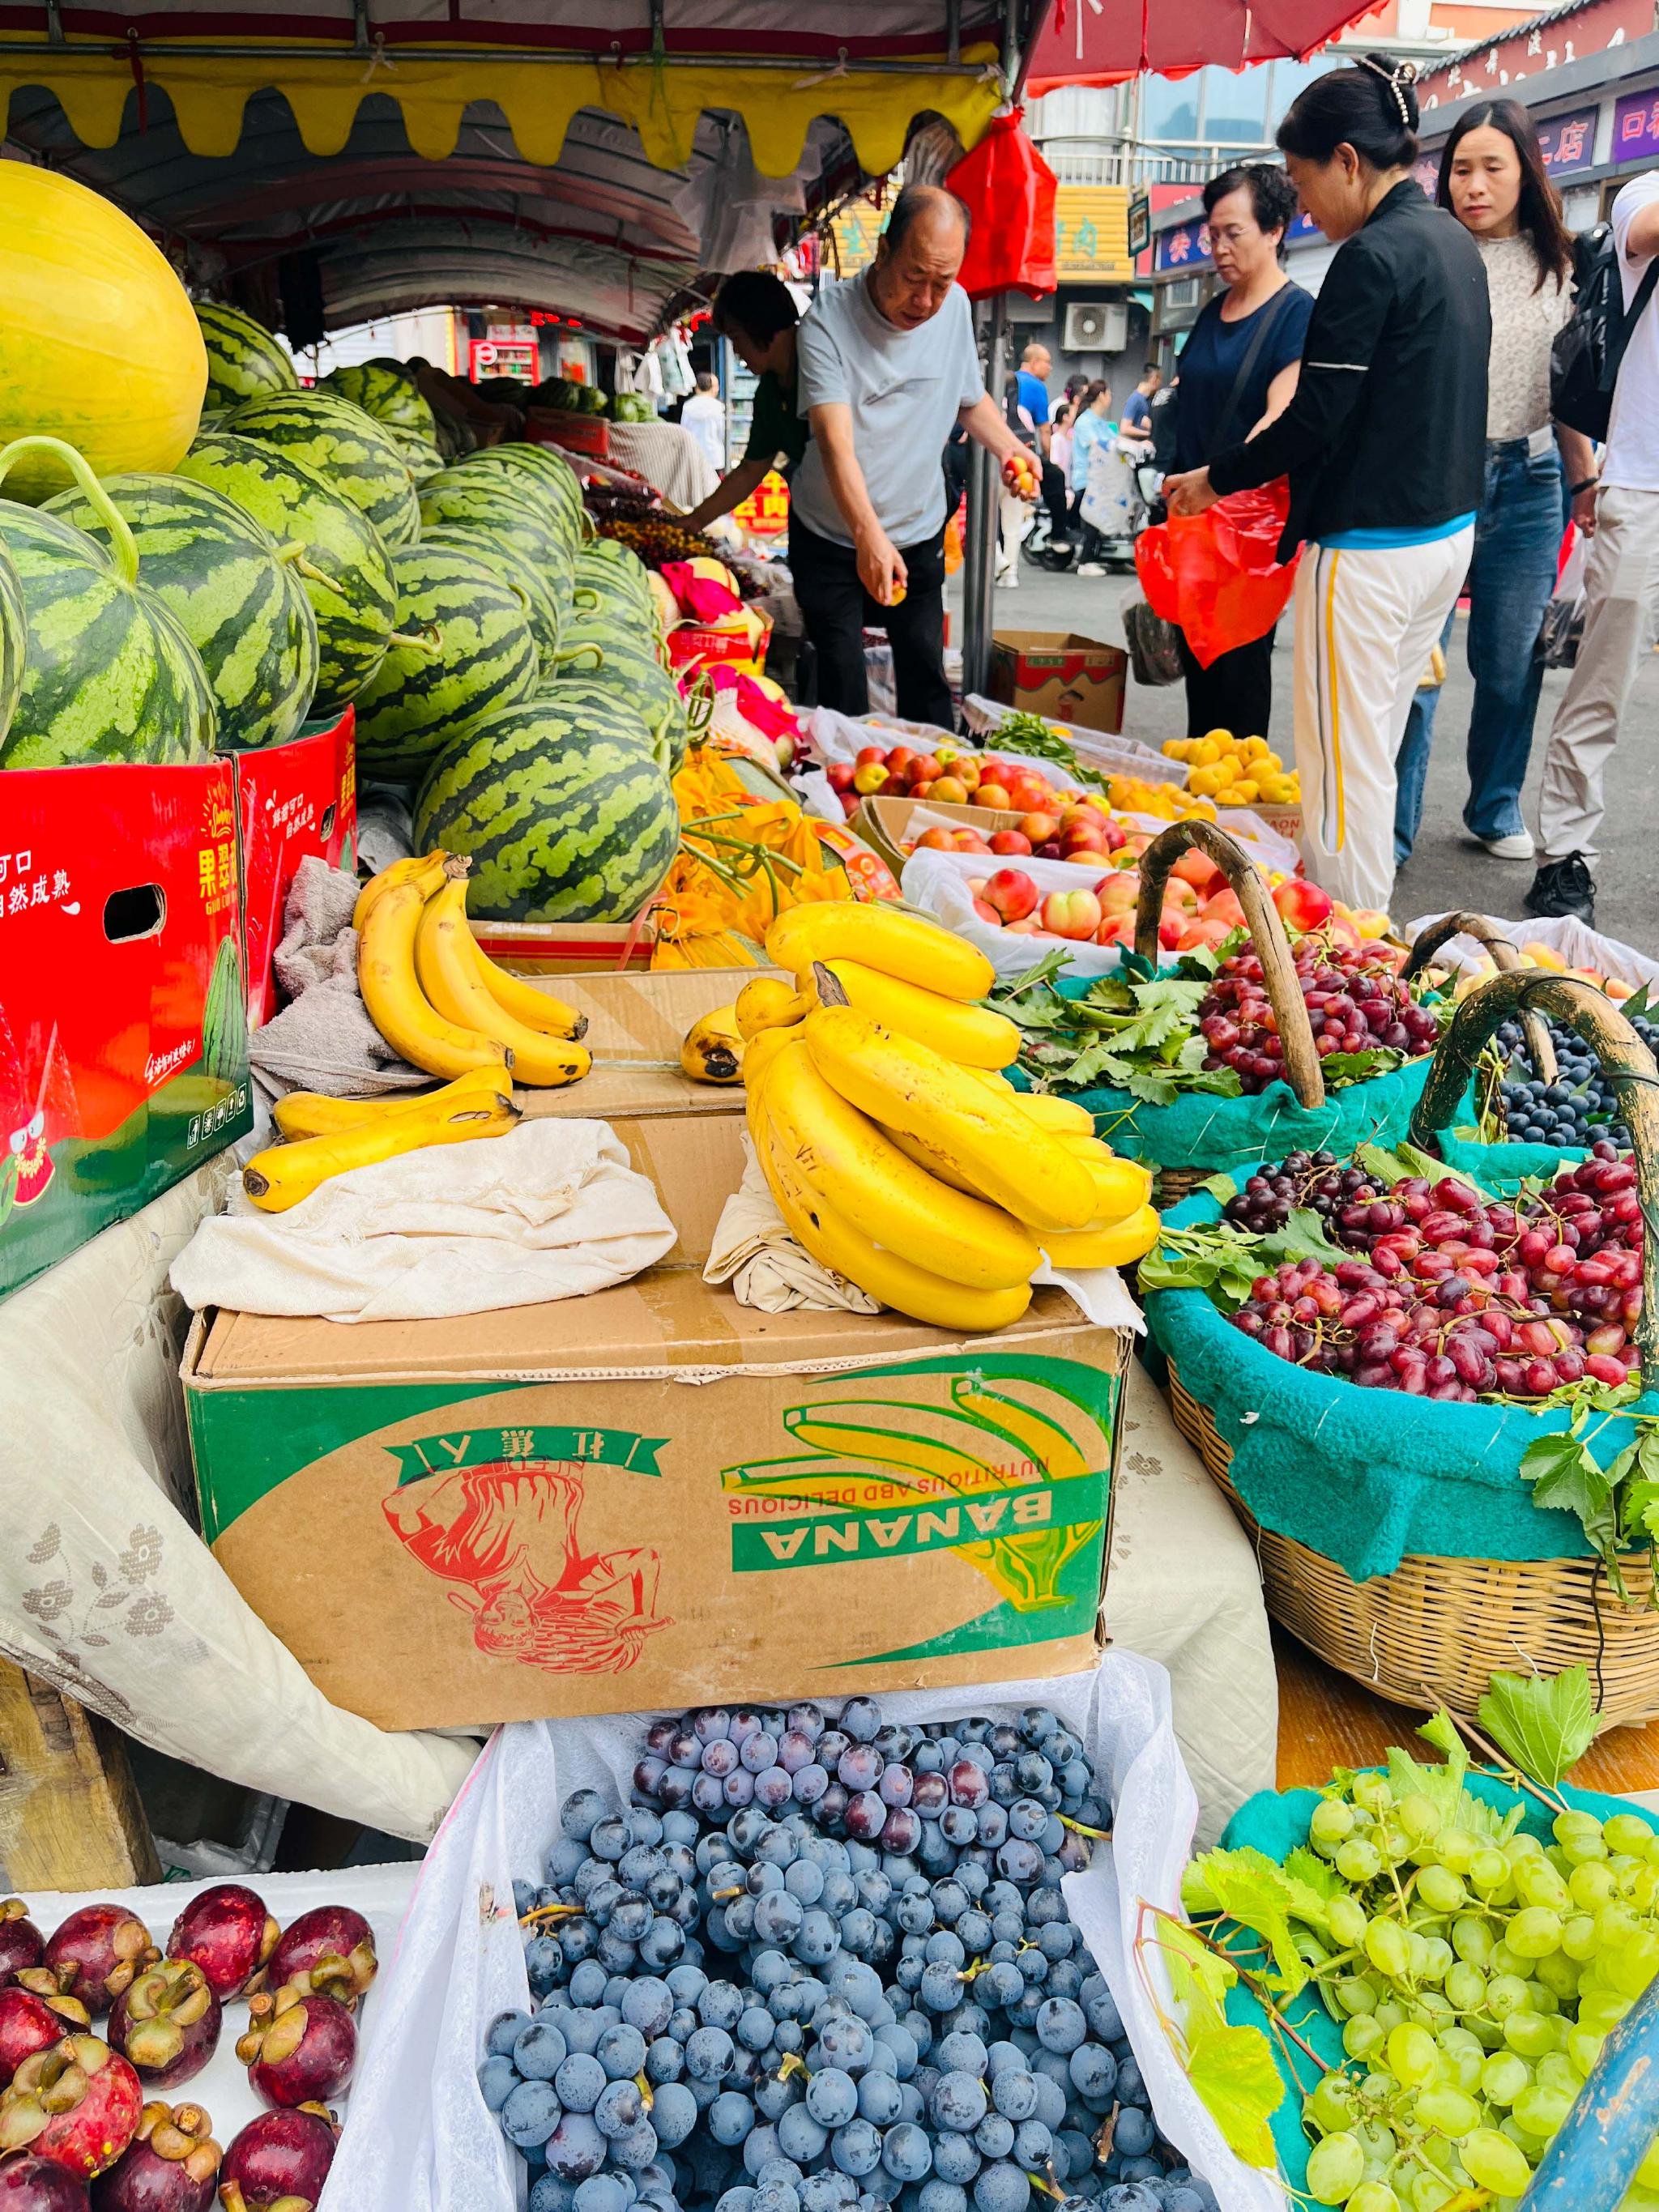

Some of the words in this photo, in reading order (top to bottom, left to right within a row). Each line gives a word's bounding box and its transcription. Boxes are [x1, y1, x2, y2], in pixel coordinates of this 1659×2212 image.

[0, 869, 70, 918] 然成熟
[438, 1430, 604, 1464] 扛蕉人
[864, 1483, 916, 1501] ABD
[918, 1457, 1050, 1494] NUTRITIOUS
[728, 1487, 855, 1515] DELICIOUS
[760, 1490, 1052, 1560] BANANA
